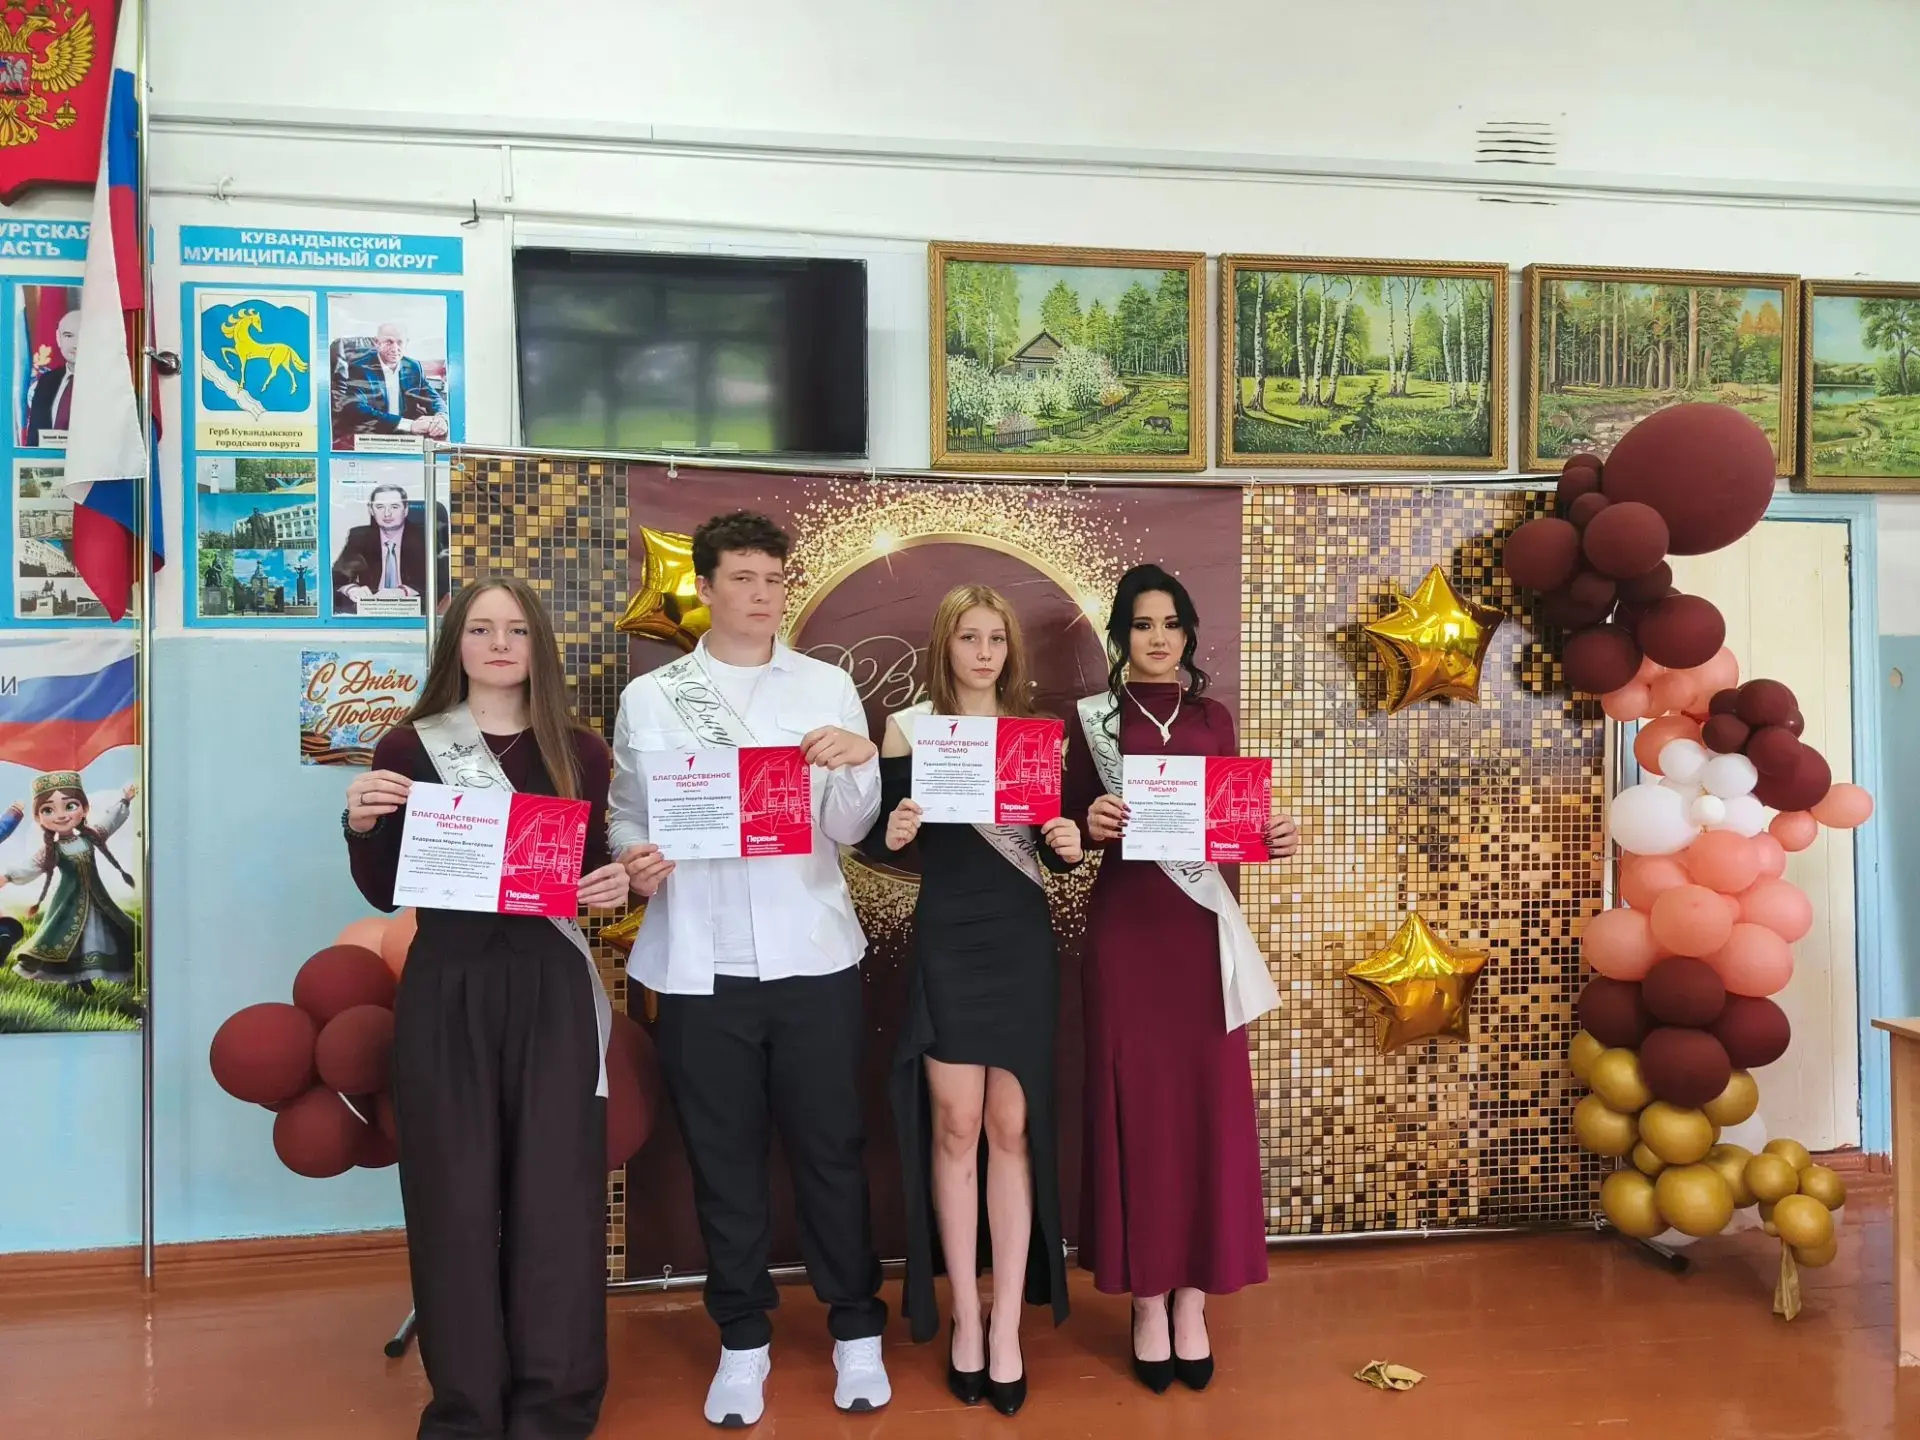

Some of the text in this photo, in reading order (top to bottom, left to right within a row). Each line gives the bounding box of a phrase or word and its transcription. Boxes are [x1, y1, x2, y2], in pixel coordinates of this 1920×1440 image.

[240, 231, 402, 250] КУВАНДЫКСКИЙ
[184, 245, 438, 269] МУНИЦИПАЛЬНЫЙ ОКРУГ
[209, 427, 303, 438] Герб Кувандыкского
[215, 439, 300, 449] городского округа
[307, 660, 418, 702] С Днём
[917, 739, 989, 747] БЛАГОДАРСТВЕННОЕ
[652, 772, 732, 782] БЛАГОДАРСТВЕННОЕ
[676, 780, 709, 788] ПИСЬМО
[1127, 779, 1199, 787] БЛАГОДАРСТВЕННОЕ
[1000, 802, 1030, 812] Первые
[411, 810, 500, 826] БЛАГОДАРСТВЕННОЕ
[436, 821, 473, 831] ПИСЬМО
[746, 834, 778, 844] Первые
[1210, 840, 1240, 851] Первые
[505, 889, 540, 901] Первые
